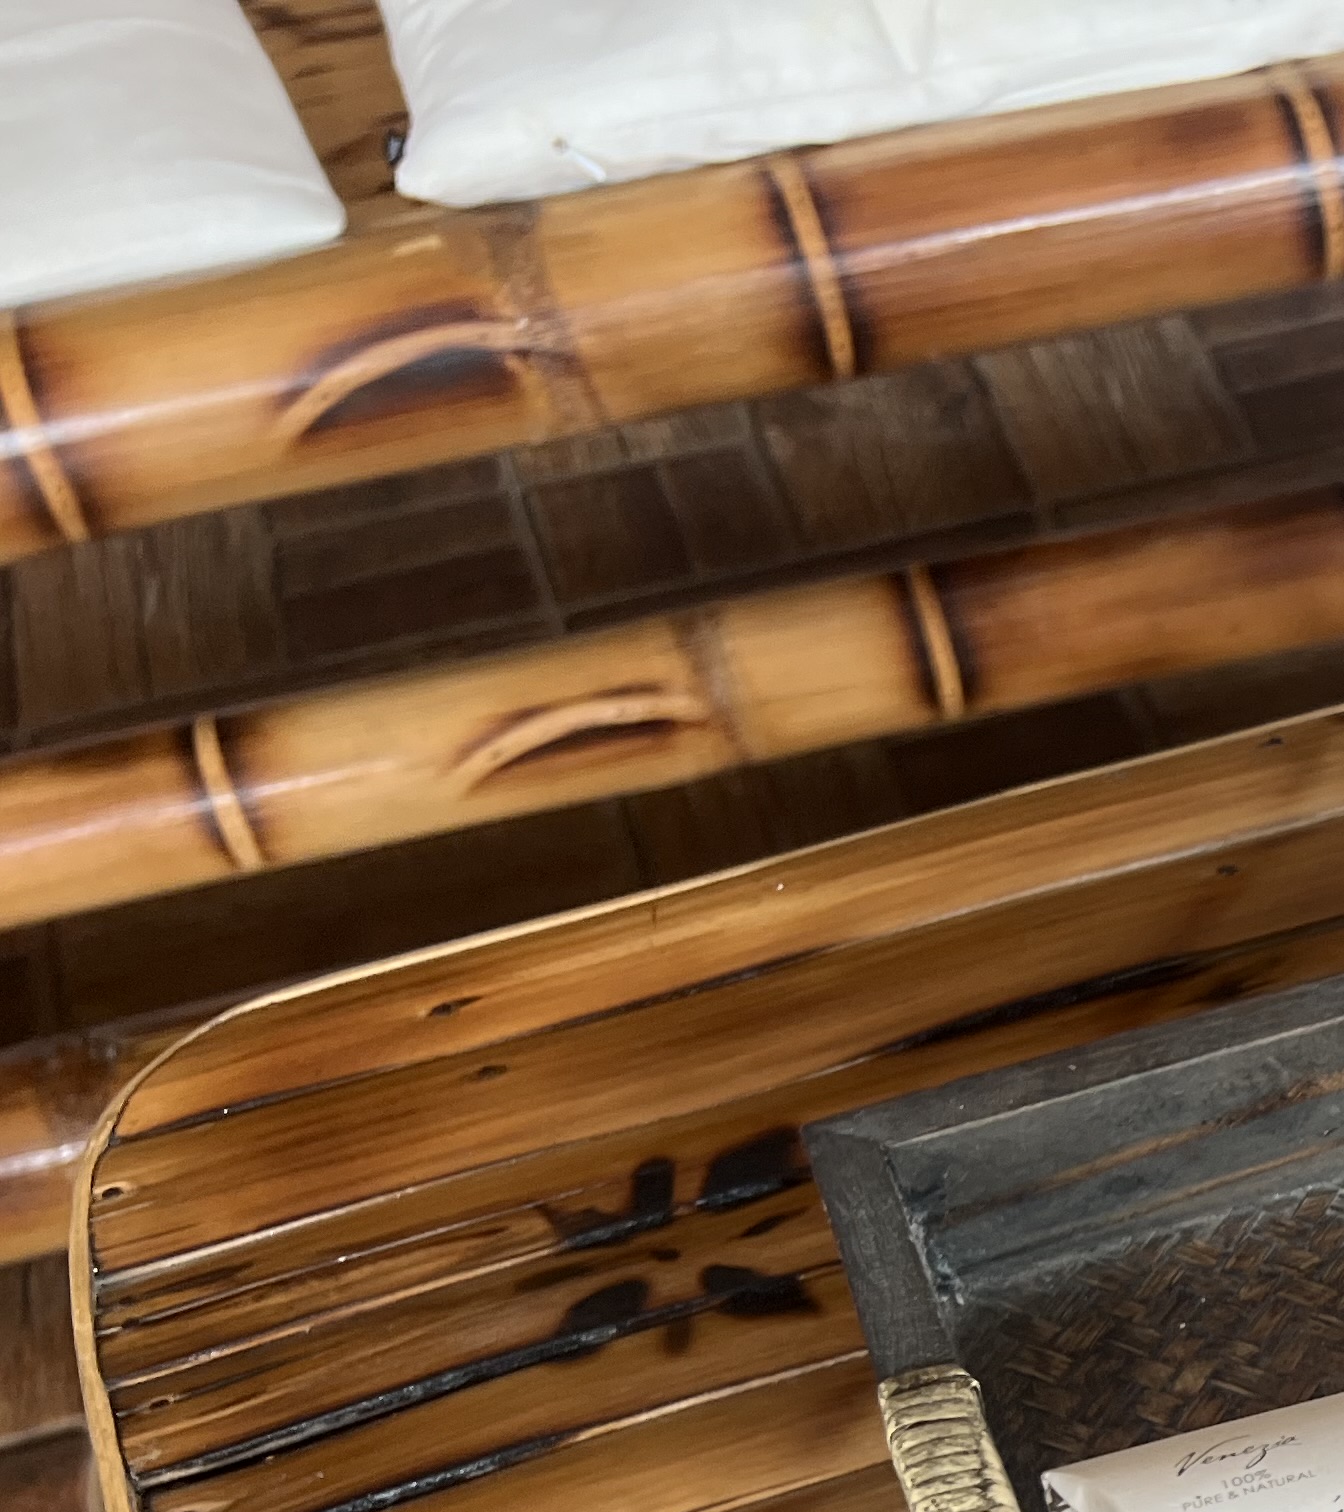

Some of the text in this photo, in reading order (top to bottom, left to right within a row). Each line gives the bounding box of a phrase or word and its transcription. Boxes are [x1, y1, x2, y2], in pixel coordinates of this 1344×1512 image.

[1175, 1434, 1303, 1477] Venezia
[1182, 1468, 1318, 1512] PURE & NATURAL
[1220, 1469, 1272, 1489] 100%
